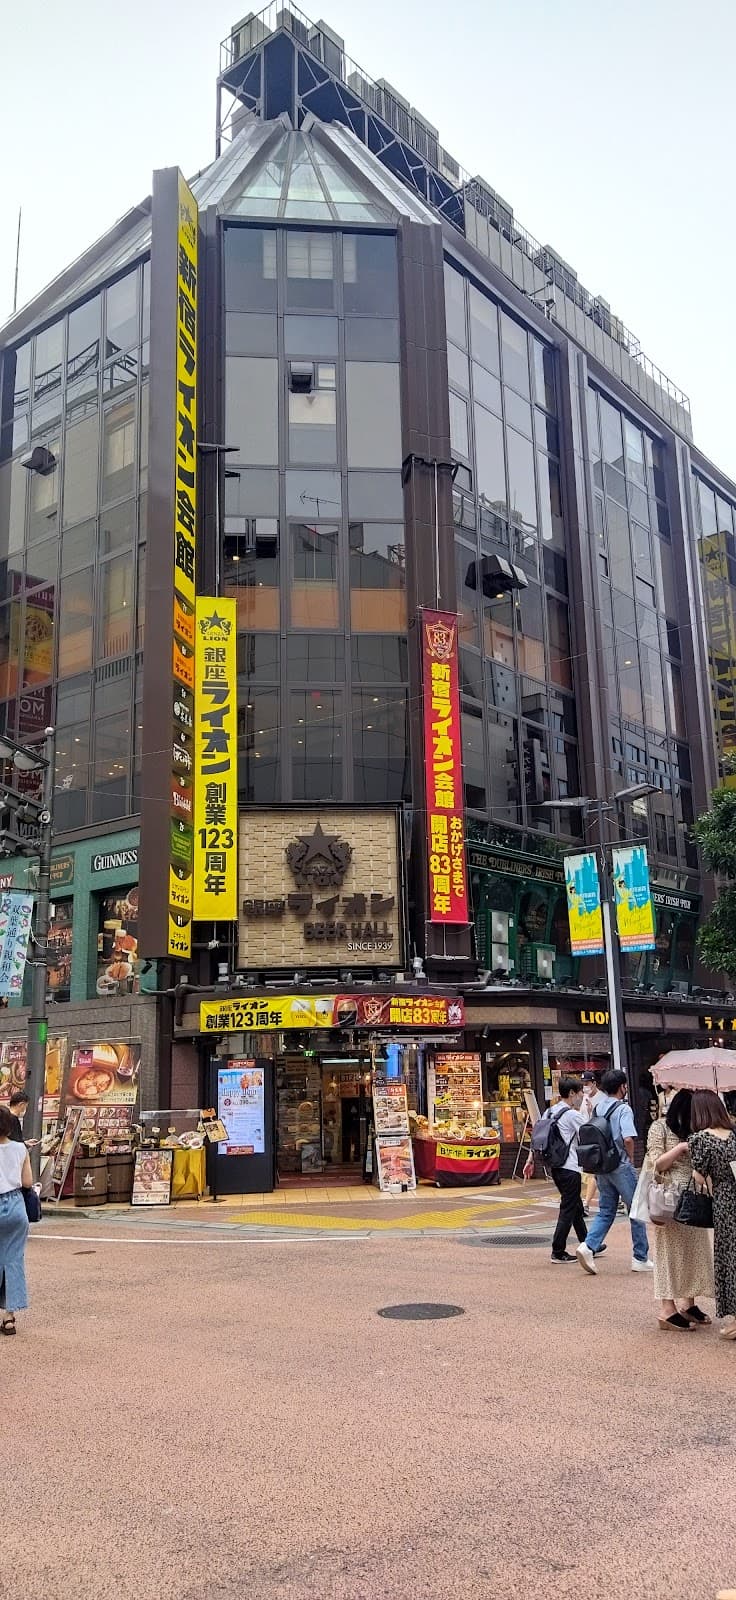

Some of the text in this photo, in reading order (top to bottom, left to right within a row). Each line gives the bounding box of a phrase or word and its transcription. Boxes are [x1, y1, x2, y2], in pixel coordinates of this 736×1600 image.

[177, 245, 197, 583] 新宿ライオン会館
[434, 631, 446, 645] 83
[431, 662, 455, 809] 新宿ライオン会館
[198, 647, 234, 896] 銀座ライオン 創業123周年
[93, 849, 138, 871] GUINNESS
[430, 814, 451, 914] 開店83周年
[450, 815, 465, 897] おかげさまで
[471, 852, 488, 866] THE
[535, 867, 555, 880] IRISH
[171, 890, 189, 904] ライオン
[665, 895, 680, 907] IRISH
[304, 921, 394, 940] BEER HALL
[170, 939, 189, 952] ライオン
[347, 942, 393, 951] SINCE 1939
[205, 1011, 282, 1029] 創業123周年
[389, 1007, 448, 1025] 開店83周年
[466, 1149, 497, 1158] ライオン
